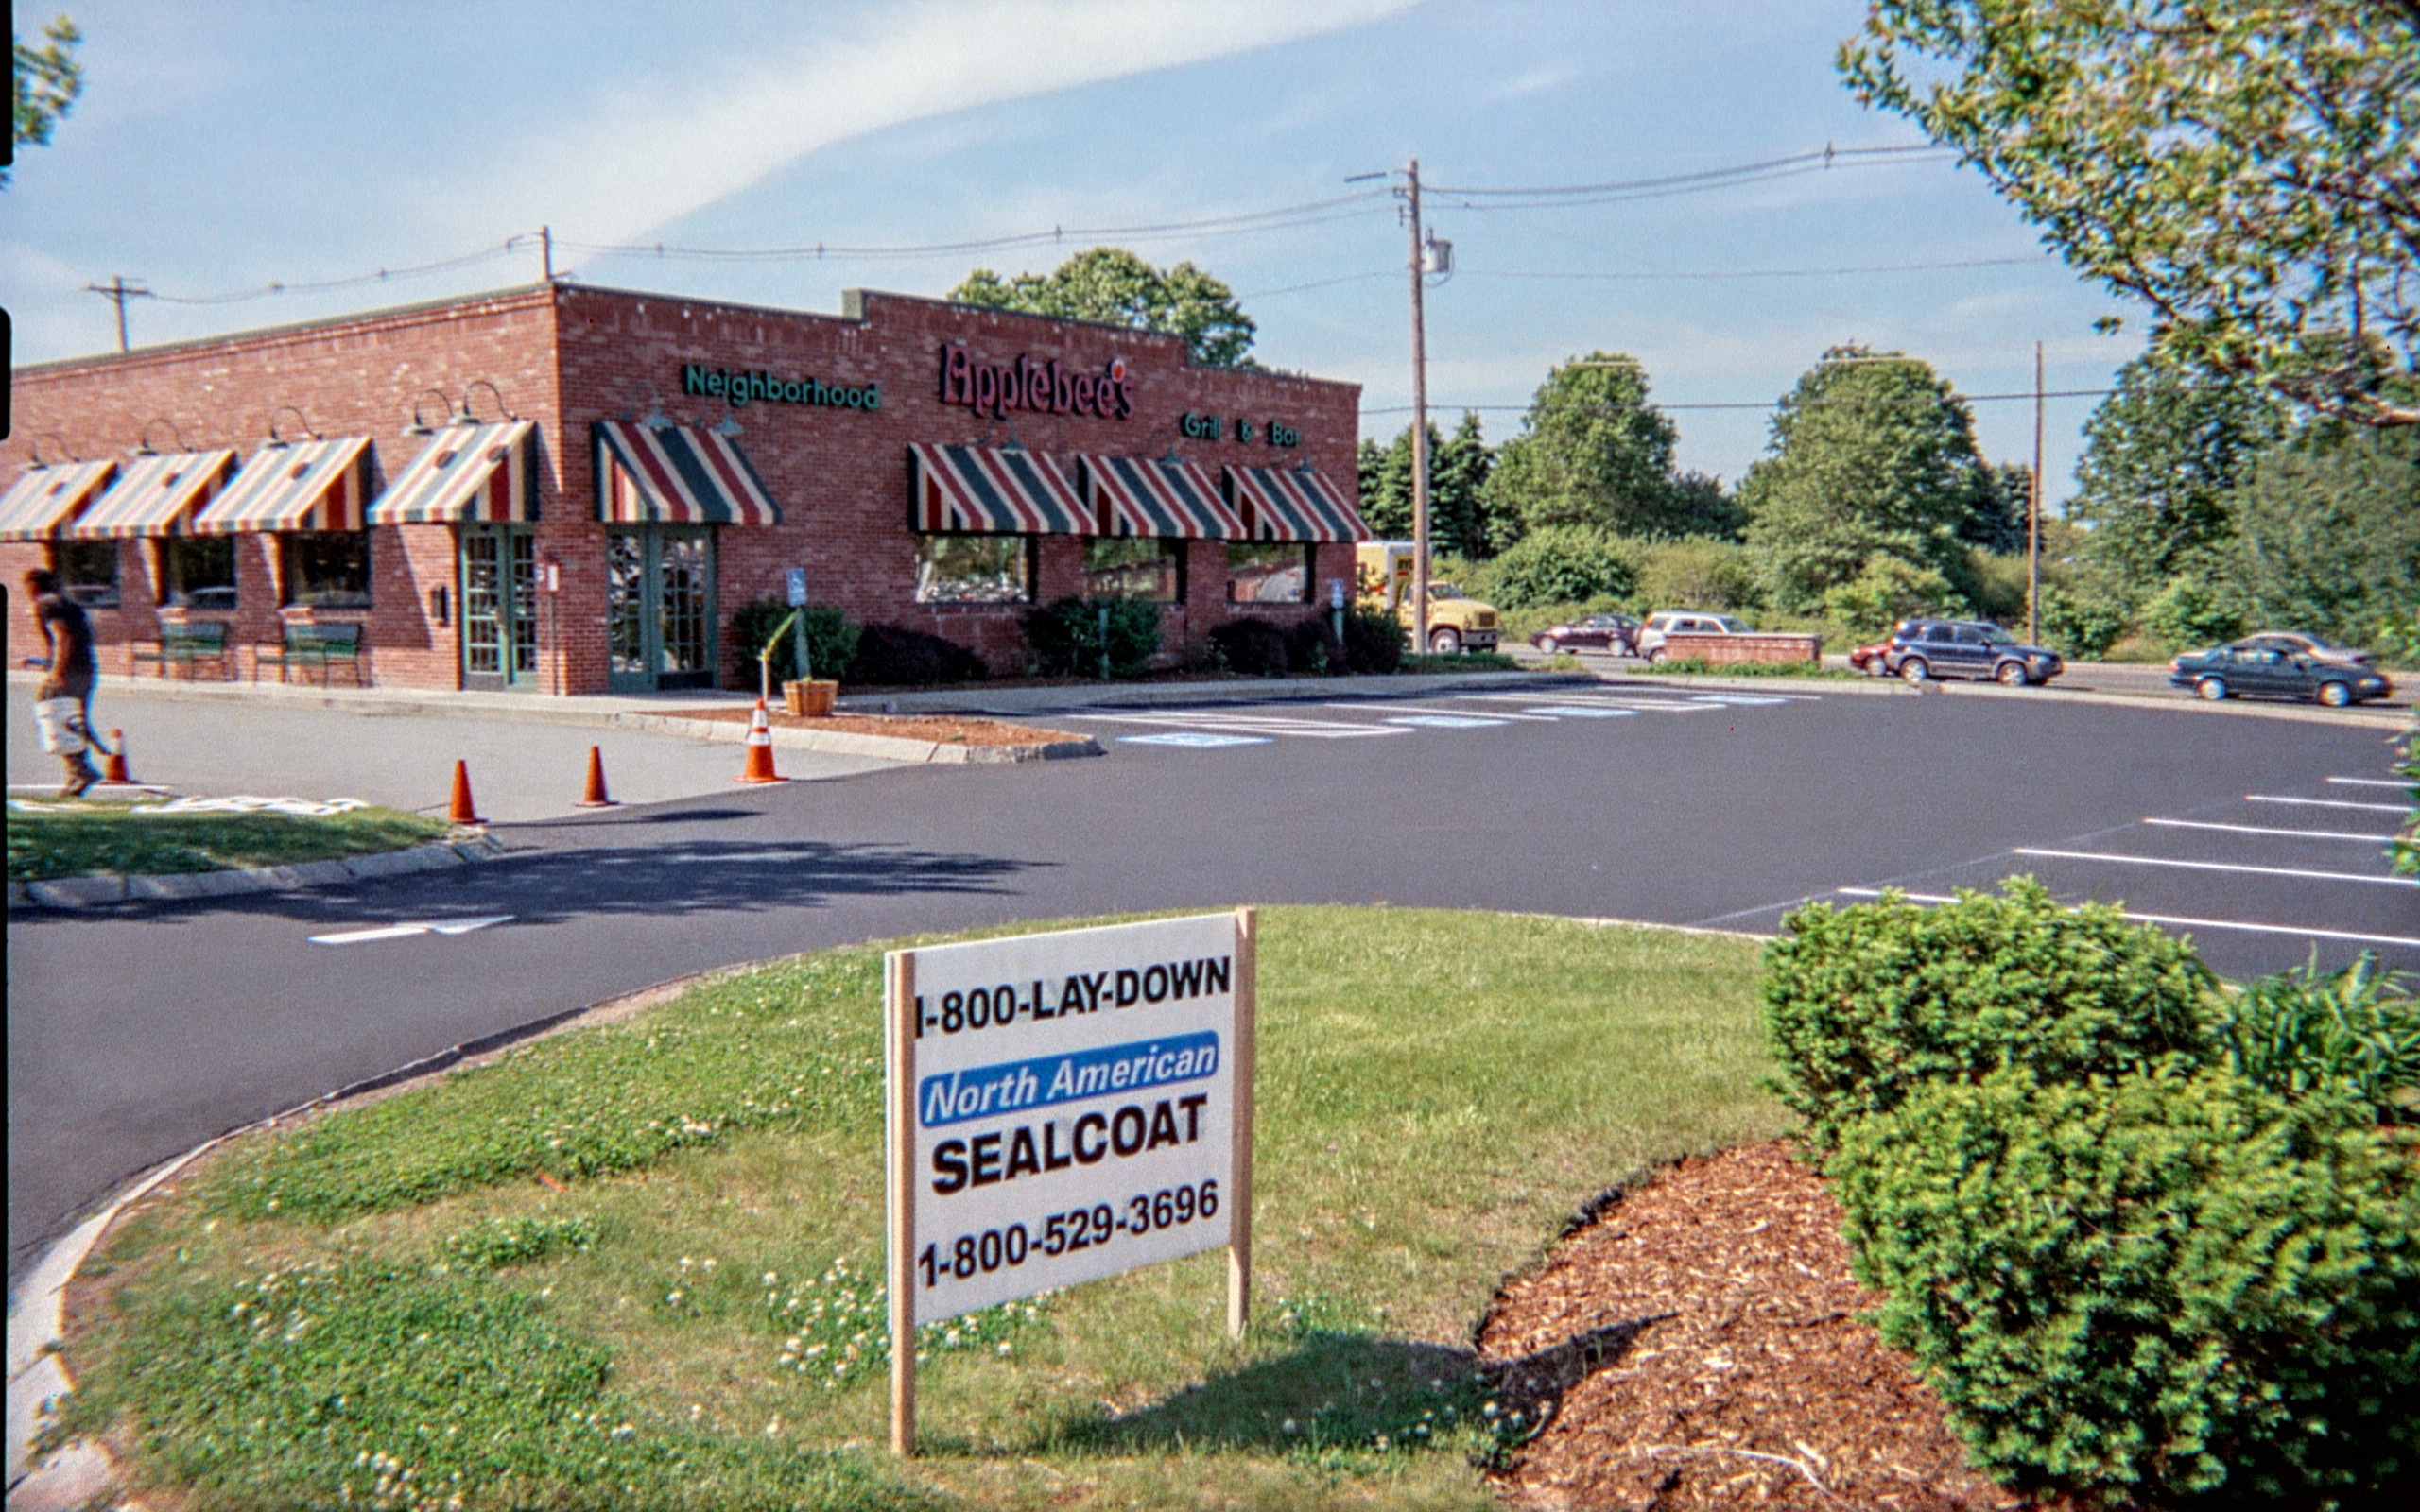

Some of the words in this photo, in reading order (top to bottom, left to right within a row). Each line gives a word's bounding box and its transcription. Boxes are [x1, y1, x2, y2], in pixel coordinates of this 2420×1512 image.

[683, 365, 880, 410] Neighborhood
[940, 344, 1133, 421] Applebee's
[1181, 413, 1221, 440] Grill
[1236, 419, 1253, 442] &
[1268, 421, 1301, 447] Bar
[915, 956, 1231, 1038] 1-800-LAY-DOWN
[925, 1071, 1037, 1122] North
[1046, 1044, 1216, 1100] American
[931, 1092, 1208, 1195] SEALCOAT
[918, 1178, 1219, 1288] 1-800-529-3696
